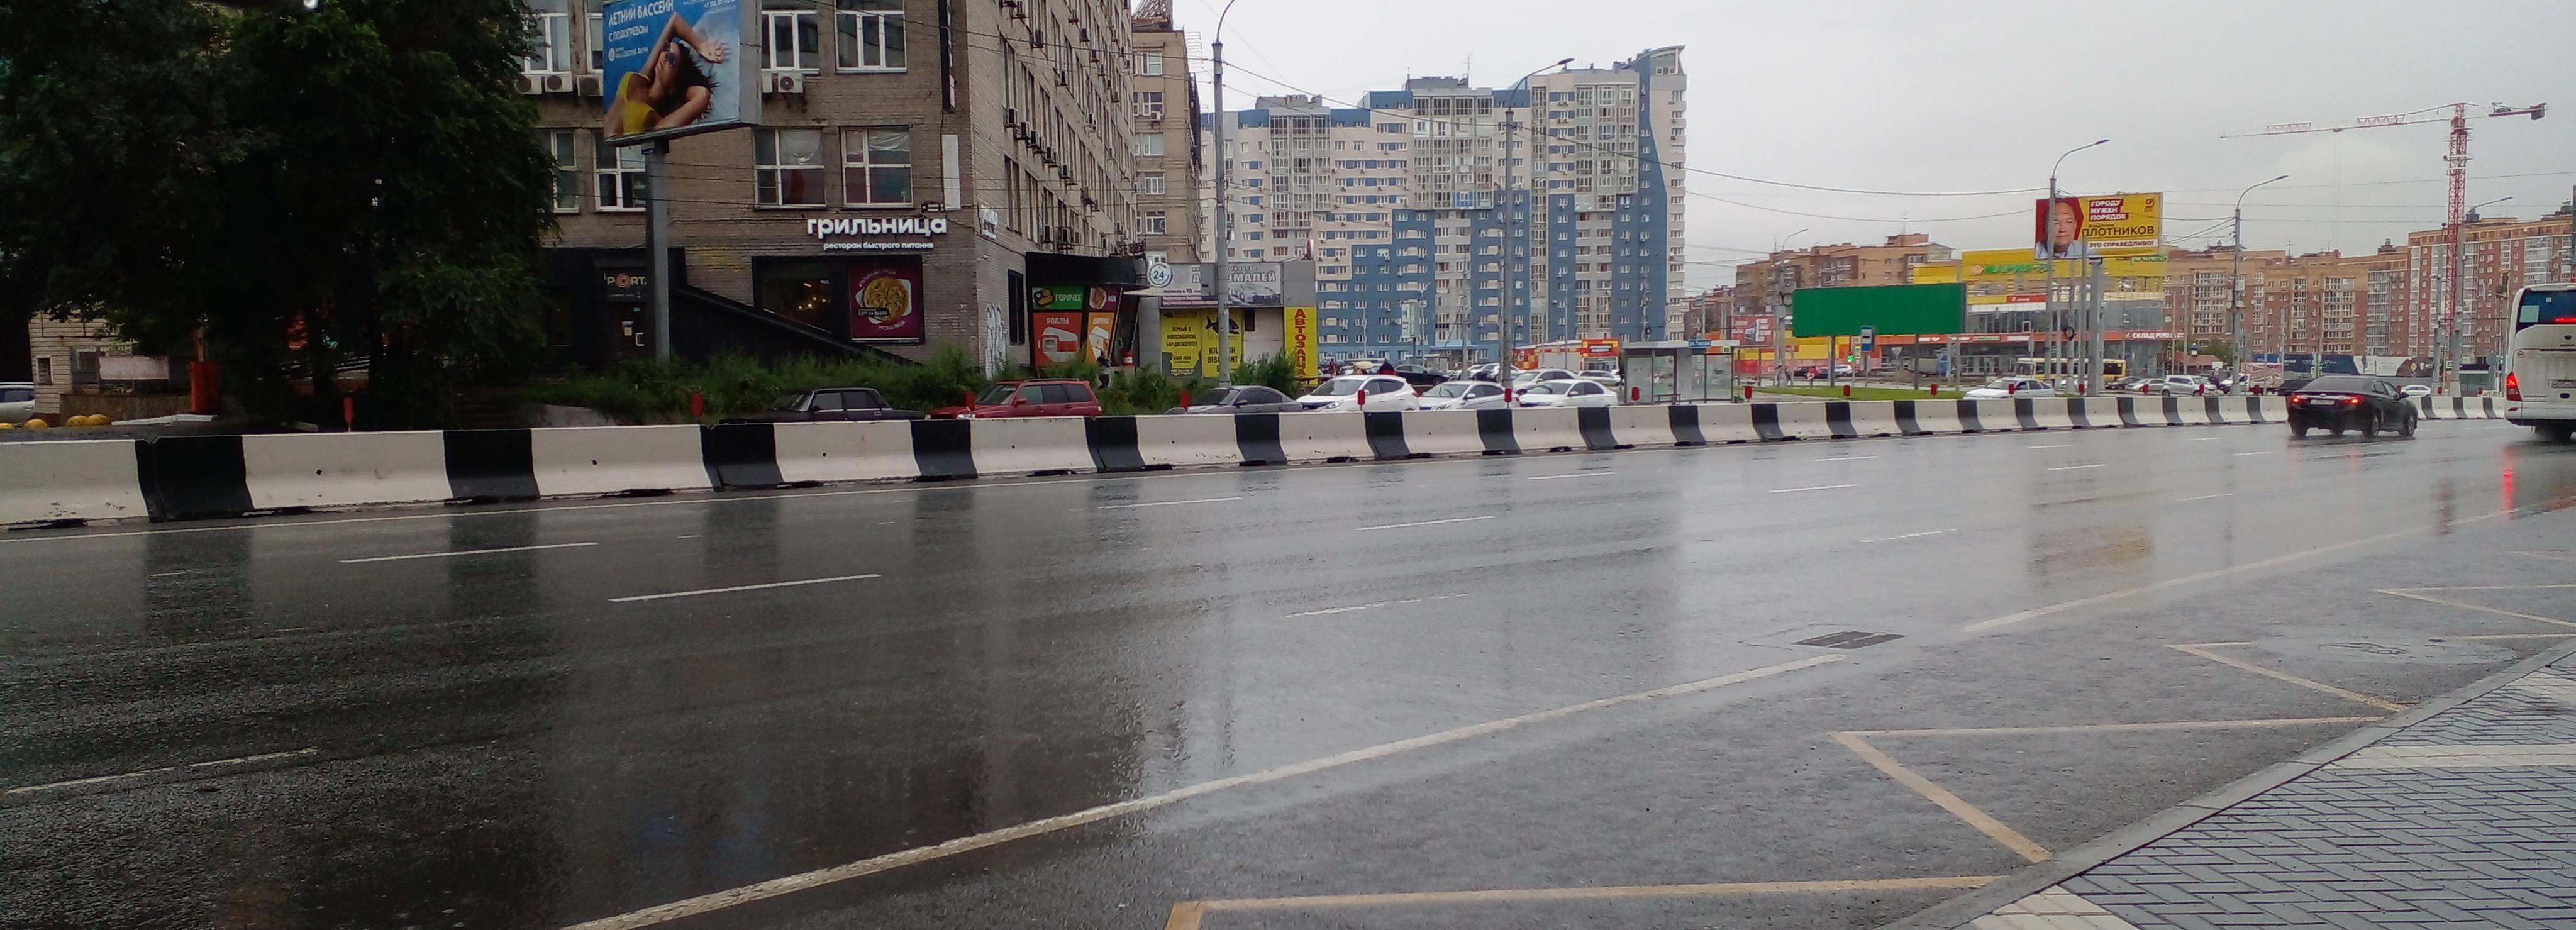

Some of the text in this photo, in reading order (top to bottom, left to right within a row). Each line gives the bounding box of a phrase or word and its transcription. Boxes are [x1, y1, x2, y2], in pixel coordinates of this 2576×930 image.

[608, 8, 637, 26] ЛЕТНИЙ
[2090, 199, 2121, 208] ГОРОДУ
[807, 218, 947, 239] грильница
[2082, 225, 2155, 236] ПЛОТНИКОВ
[823, 240, 935, 250] ресторан быстрого питания
[1153, 270, 1165, 280] 24
[1055, 294, 1082, 302] ГОРЯЧЕЕ
